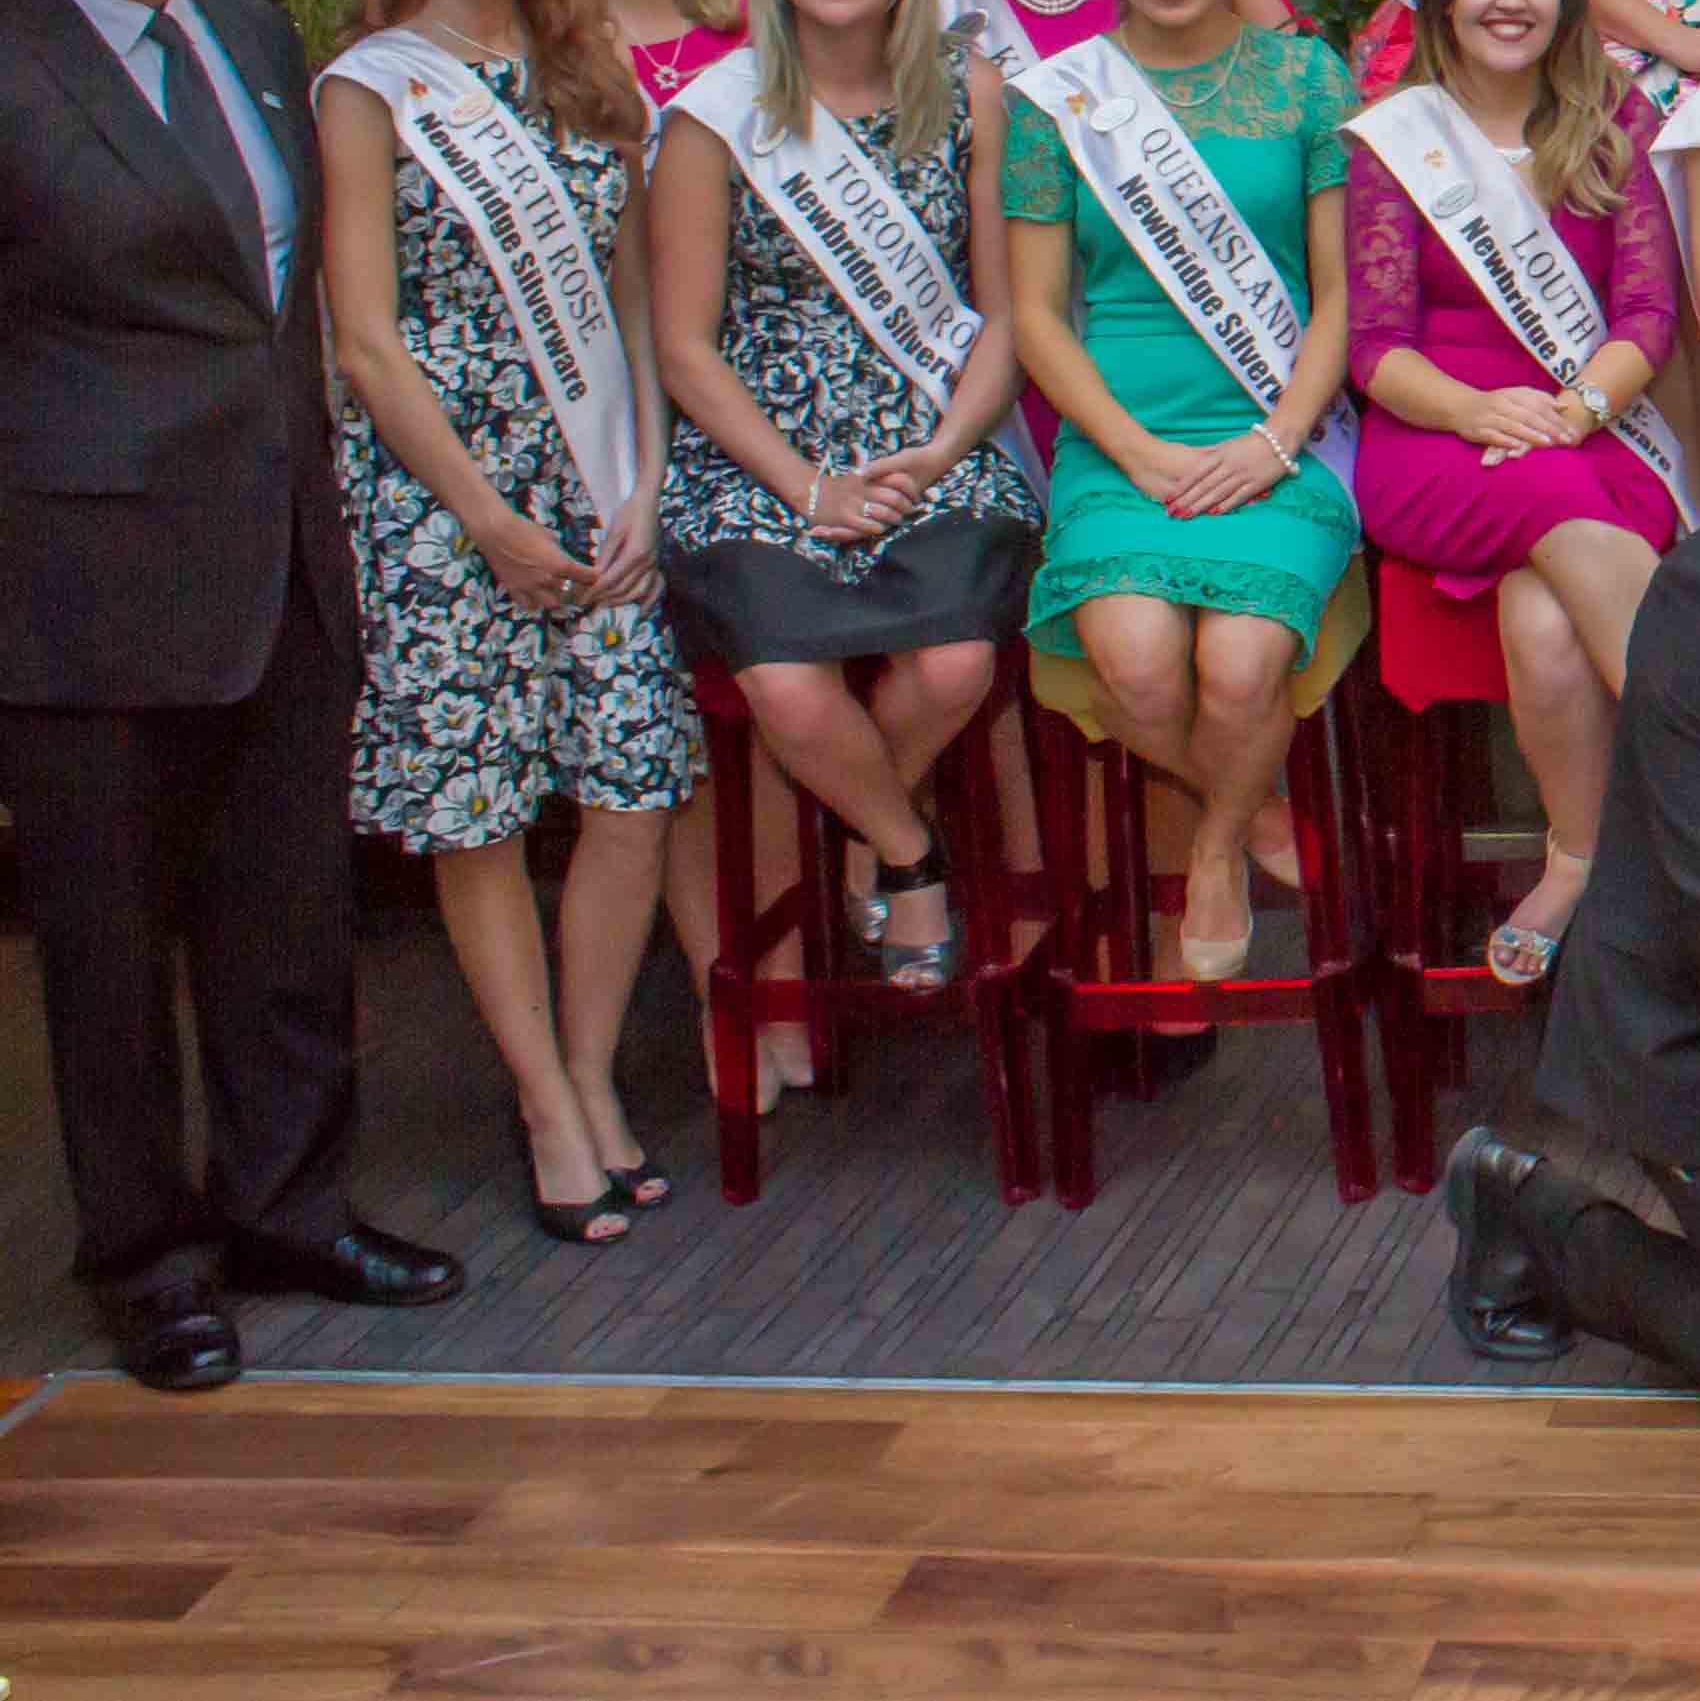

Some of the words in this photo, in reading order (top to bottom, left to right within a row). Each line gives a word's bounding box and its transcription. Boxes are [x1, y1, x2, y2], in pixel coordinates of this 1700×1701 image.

[414, 110, 523, 254] Newbridge
[509, 250, 588, 403] Silverware
[472, 117, 568, 242] PERTH
[547, 242, 608, 347] ROSE
[780, 171, 894, 311] Newbridge
[825, 153, 941, 309] TORONTO
[1116, 172, 1225, 318] Newbridge
[1140, 126, 1297, 350] QUEENSLAND
[1458, 216, 1559, 362] Newbridge
[1512, 229, 1600, 349] LOUTH
